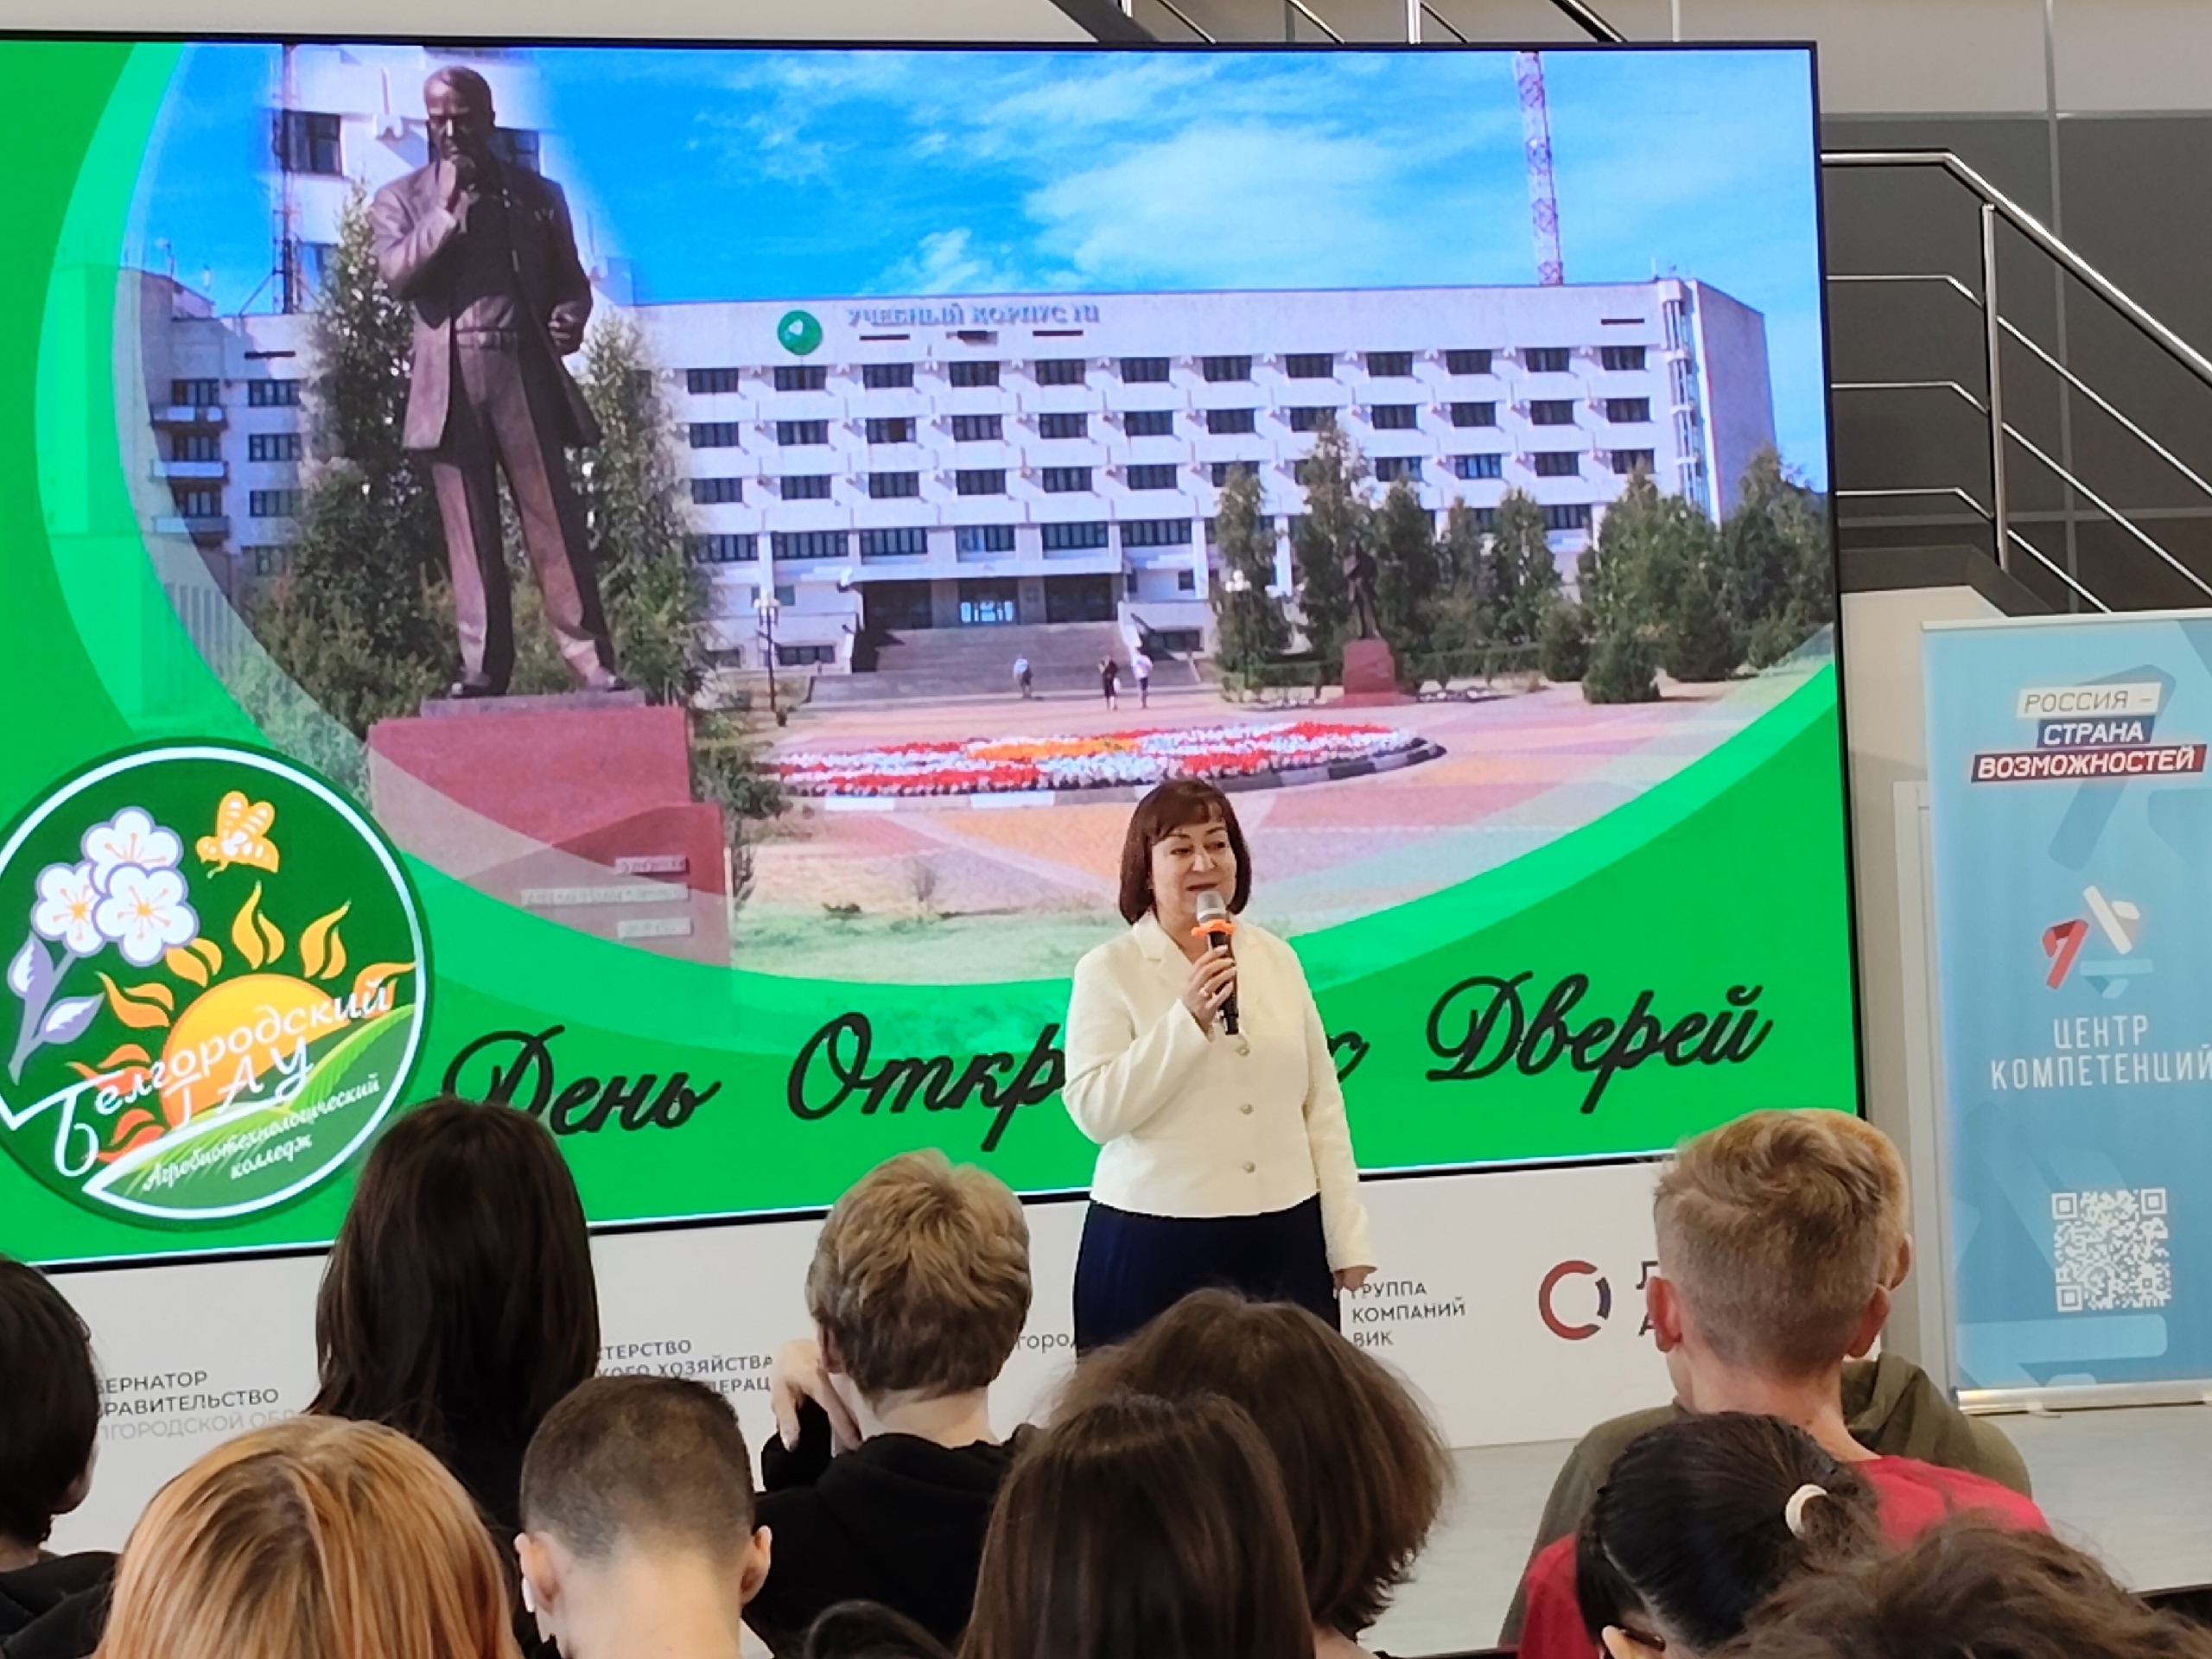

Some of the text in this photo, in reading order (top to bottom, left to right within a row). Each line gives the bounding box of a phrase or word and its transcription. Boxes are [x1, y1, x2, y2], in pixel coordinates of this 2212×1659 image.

[2024, 690, 2129, 714] РОССИЯ
[2043, 720, 2145, 746] СТРАНА
[1977, 744, 2196, 779] ВОЗМОЖНОСТЕЙ
[2053, 1014, 2149, 1050] ЦЕНТР
[442, 1024, 722, 1135] День
[1425, 970, 1774, 1115] Дверей
[1990, 1042, 2212, 1090] КОМПЕТЕНЦИЙ
[13, 976, 391, 1178] Белгородский
[230, 1134, 314, 1180] колледж
[1351, 1296, 1466, 1324] КОМПАНИЙ
[601, 1339, 692, 1360] ТЕРСТВО
[1352, 1331, 1395, 1348] ВИК
[101, 1388, 280, 1417] РАВИТЕЛЬСТВО
